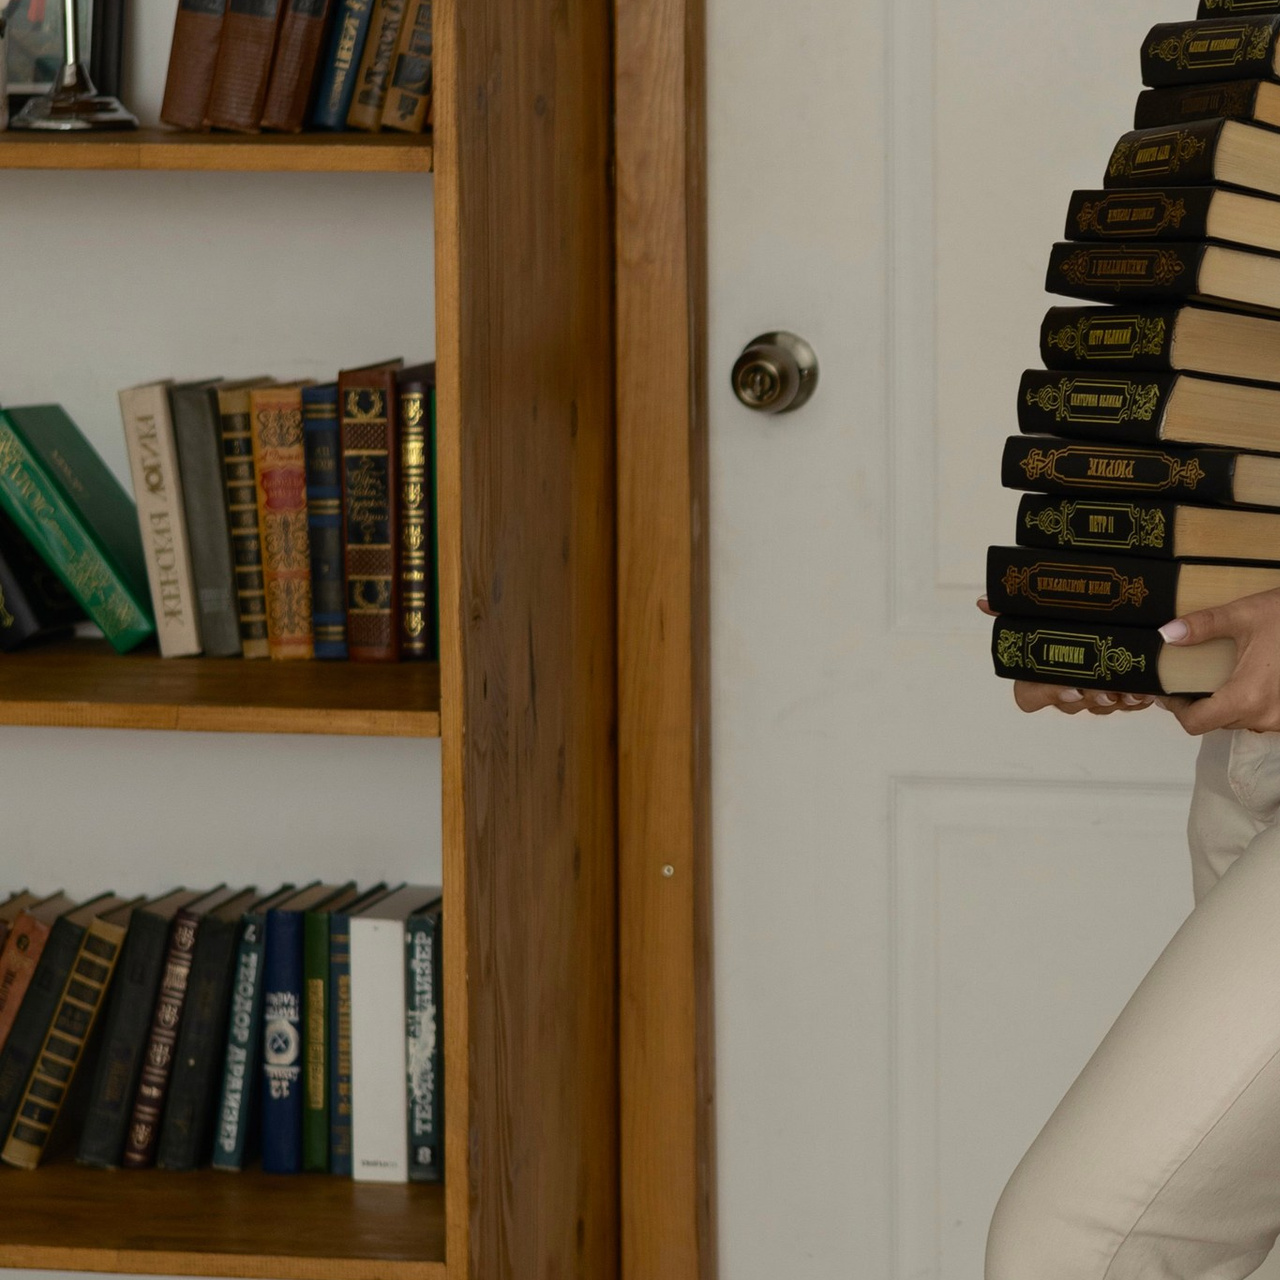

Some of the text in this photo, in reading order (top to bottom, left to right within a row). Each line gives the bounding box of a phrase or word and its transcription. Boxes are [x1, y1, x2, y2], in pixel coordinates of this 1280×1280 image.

[1087, 457, 1136, 478] РЮРИК
[1088, 514, 1114, 533] ПЕТР II
[1088, 579, 1112, 595] ЮРИЙ
[1048, 643, 1085, 663] НИКОЛАЙ
[229, 950, 259, 1043] ТЕОДОР
[417, 1146, 432, 1164] 8
